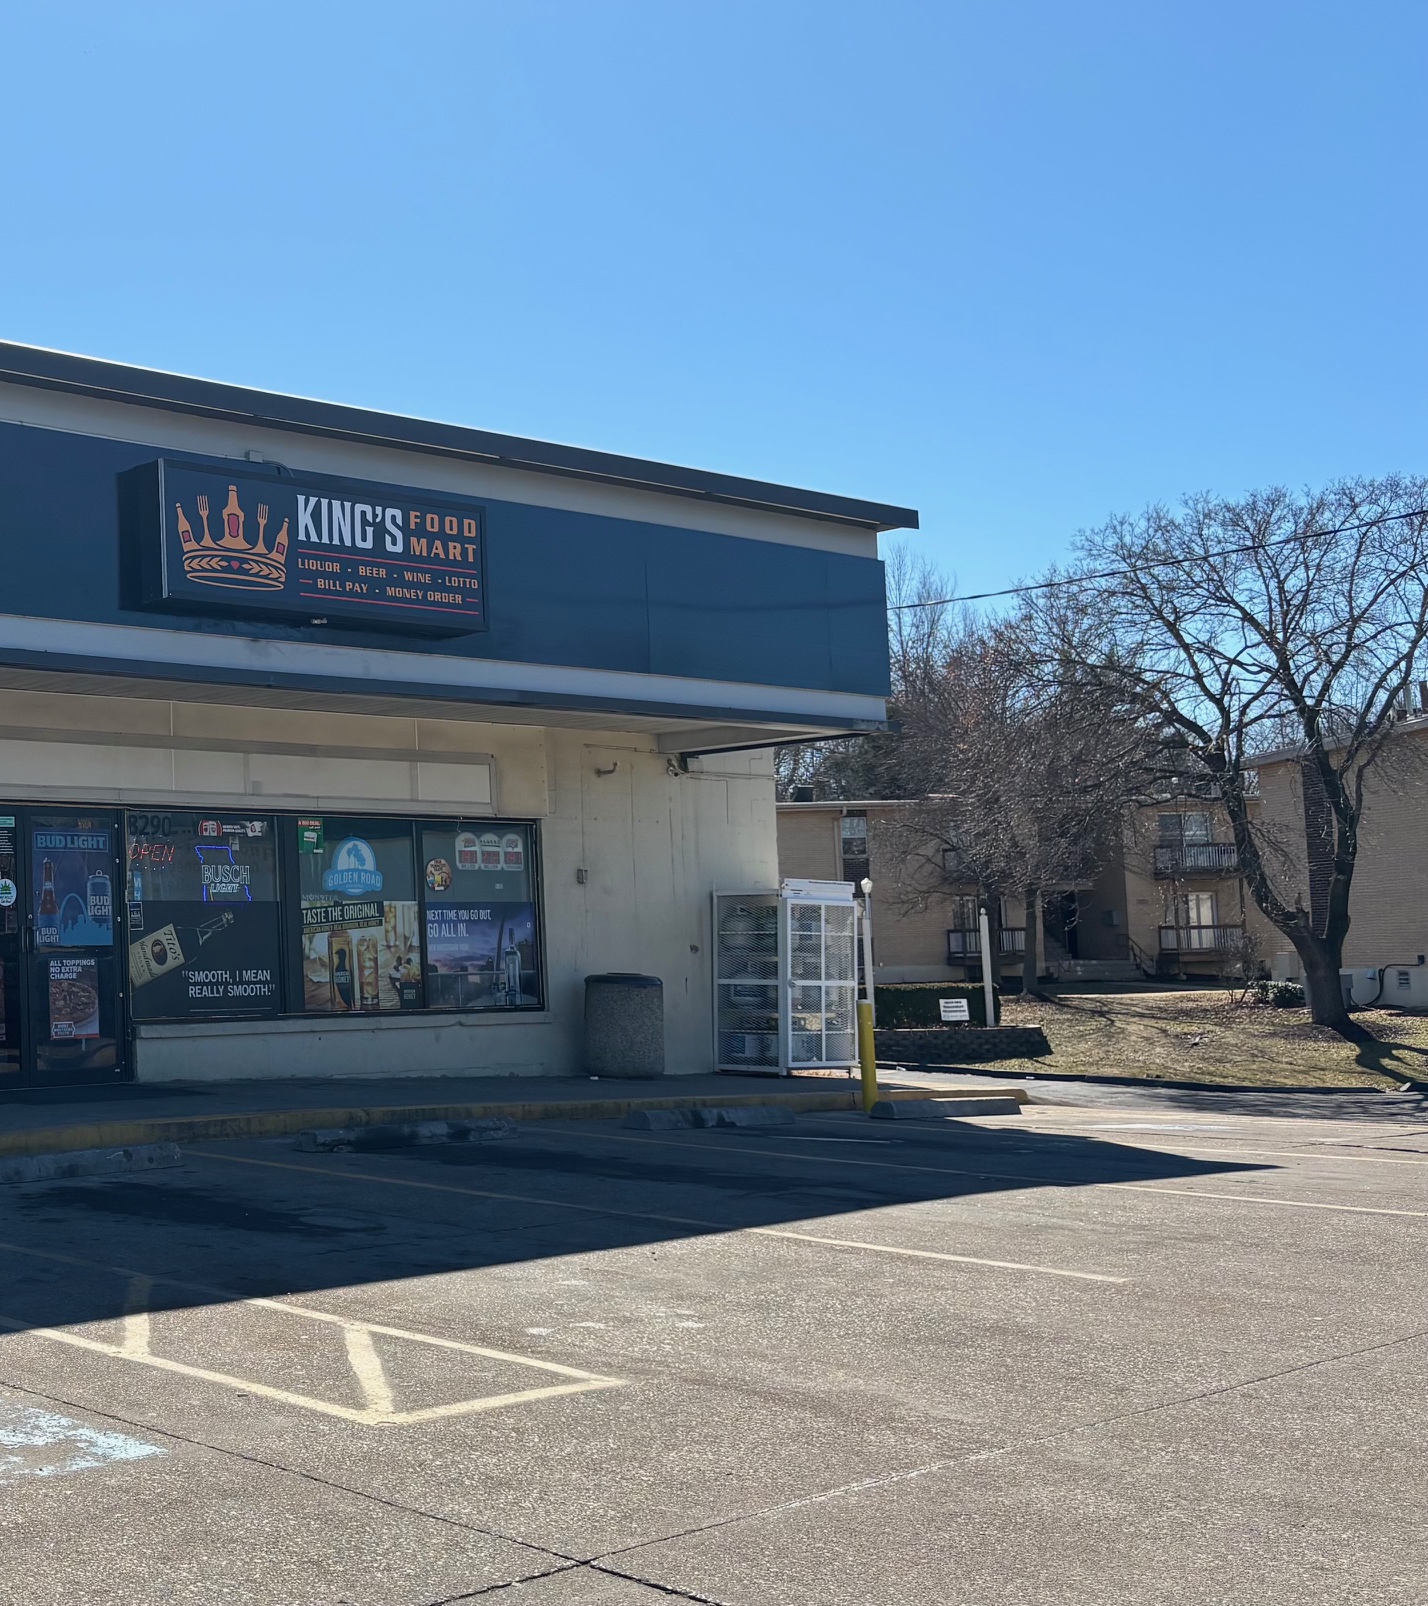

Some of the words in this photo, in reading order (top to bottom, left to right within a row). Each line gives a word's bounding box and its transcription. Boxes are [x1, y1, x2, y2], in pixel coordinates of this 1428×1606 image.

[296, 494, 403, 554] KING'S
[409, 510, 477, 538] FOOD
[409, 536, 477, 563] MART
[298, 558, 341, 574] LIQUOR
[358, 565, 387, 579] BEER
[403, 570, 432, 584] WINE
[445, 575, 478, 589] LOTTO
[317, 578, 343, 592] BILL
[345, 581, 369, 594] PAY
[386, 585, 424, 600] MONEY
[427, 590, 462, 605] ORDER
[36, 835, 66, 848] BUD
[66, 836, 105, 849] LIGHT
[129, 843, 174, 862] OPEN
[201, 865, 251, 885] BUSCH
[328, 871, 359, 887] GOLDEN
[362, 872, 381, 887] ROAD
[90, 895, 110, 906] BUD
[88, 905, 111, 916] LIGHT
[302, 908, 326, 925] TASTE
[327, 905, 343, 921] THE
[344, 902, 380, 920] ORIGINAL
[426, 910, 443, 921] NEXT
[443, 910, 457, 920] TIME
[457, 910, 470, 920] YOU
[470, 910, 479, 920] GO
[41, 927, 58, 935] BUD
[427, 923, 439, 938] GO
[441, 923, 457, 937] ALL
[458, 922, 469, 937] IN.
[39, 934, 59, 943] LIGHT
[163, 929, 181, 961] Tito's
[236, 970, 239, 982] I
[242, 969, 270, 982] MEAN
[189, 985, 224, 998] REALLY
